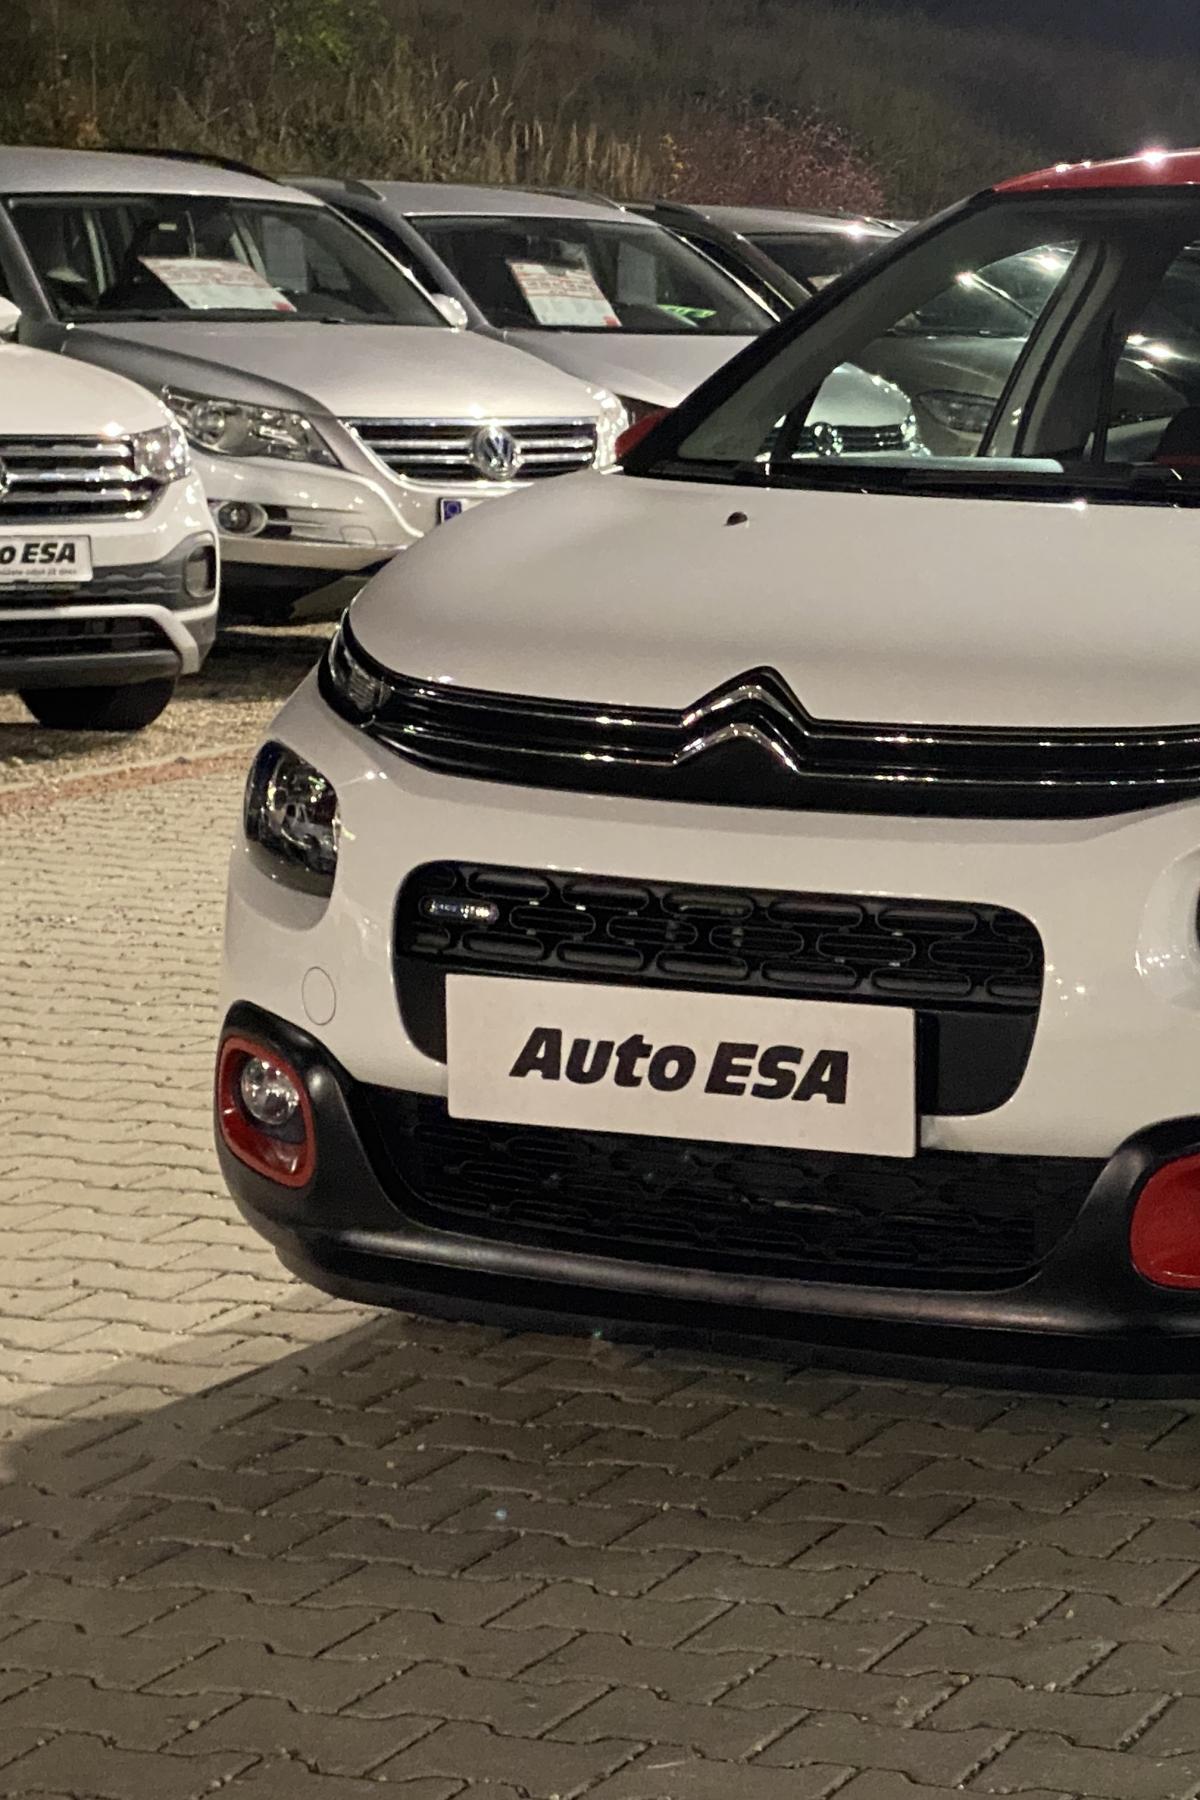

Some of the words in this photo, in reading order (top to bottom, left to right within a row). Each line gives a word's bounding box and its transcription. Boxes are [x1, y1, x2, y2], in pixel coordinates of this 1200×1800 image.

[20, 542, 76, 564] ESA
[508, 1027, 696, 1092] Auto
[704, 1042, 849, 1105] ESA
